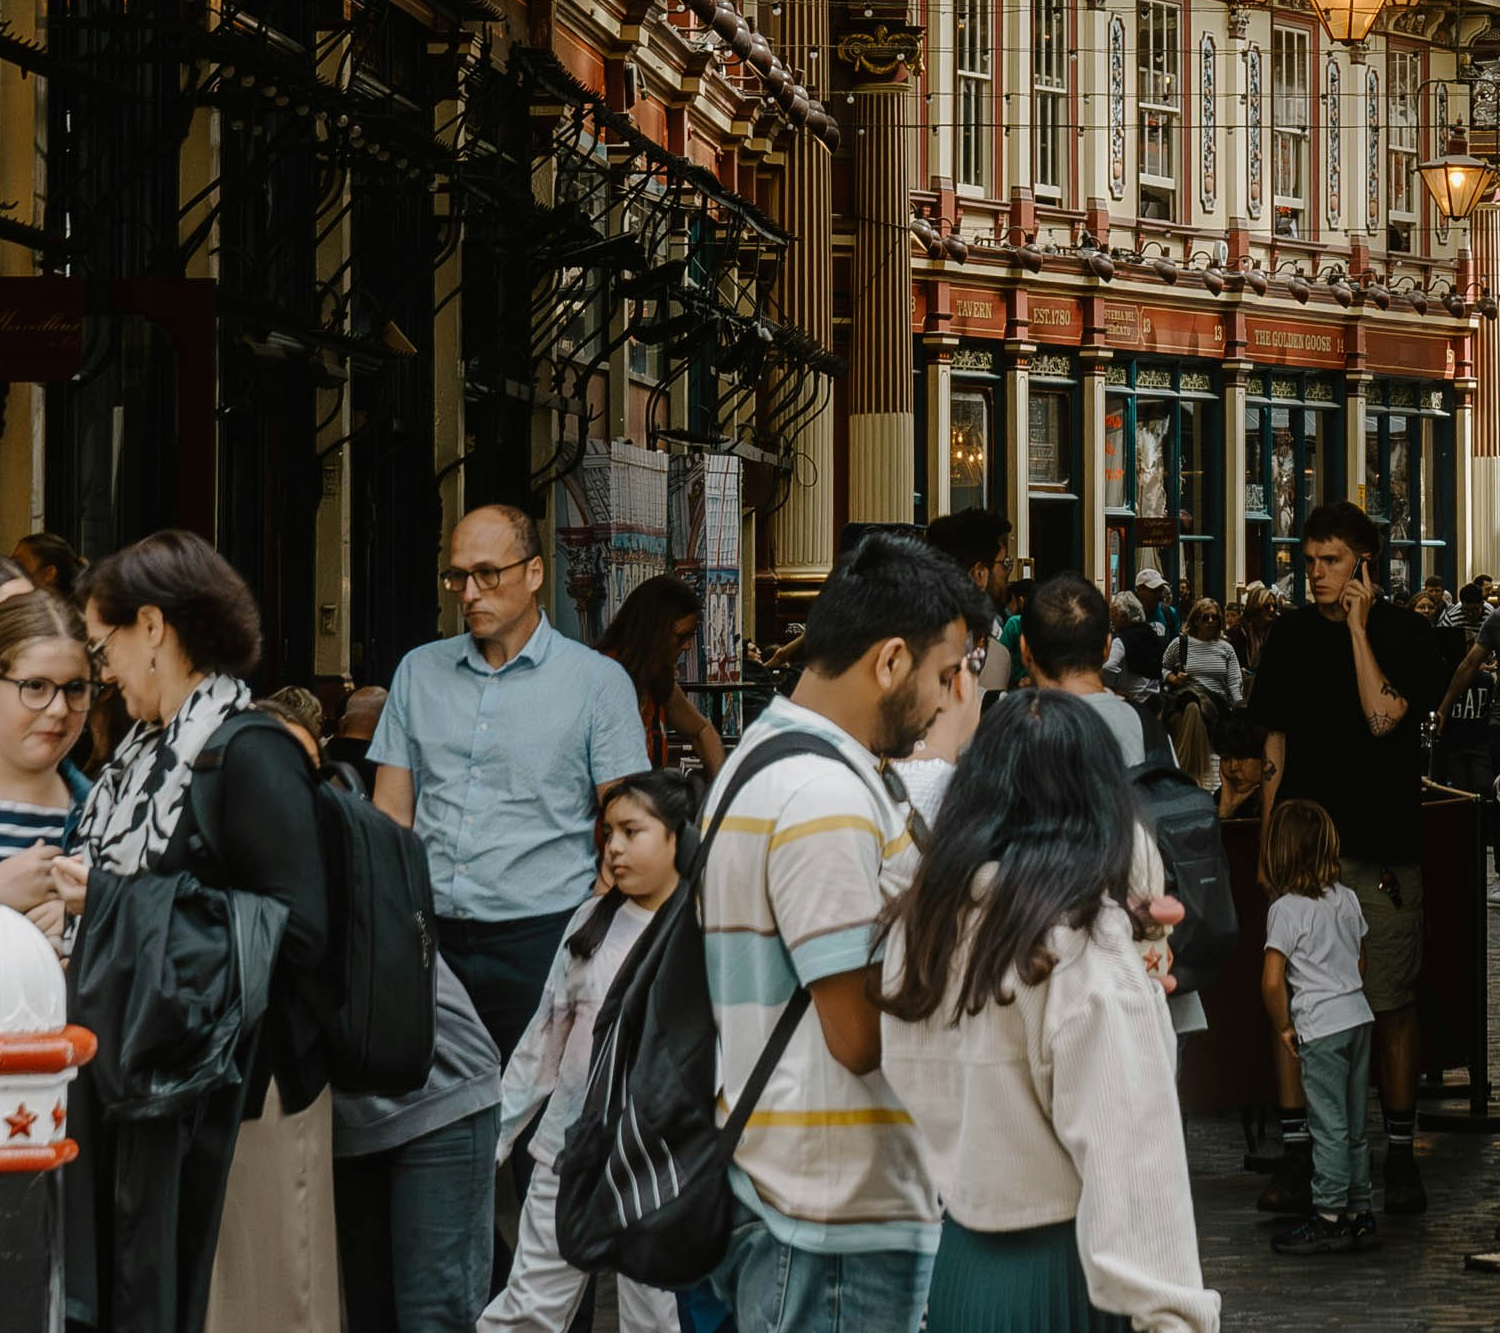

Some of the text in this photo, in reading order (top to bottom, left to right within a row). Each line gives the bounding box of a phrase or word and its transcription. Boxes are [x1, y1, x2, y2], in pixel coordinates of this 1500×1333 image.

[956, 299, 993, 320] TAVERN
[1033, 307, 1072, 327] EST.1780
[1104, 309, 1124, 321] STERIA
[1143, 317, 1152, 334] 13
[1214, 325, 1222, 341] 13
[1254, 329, 1332, 353] THE GOLDEN GOOSE
